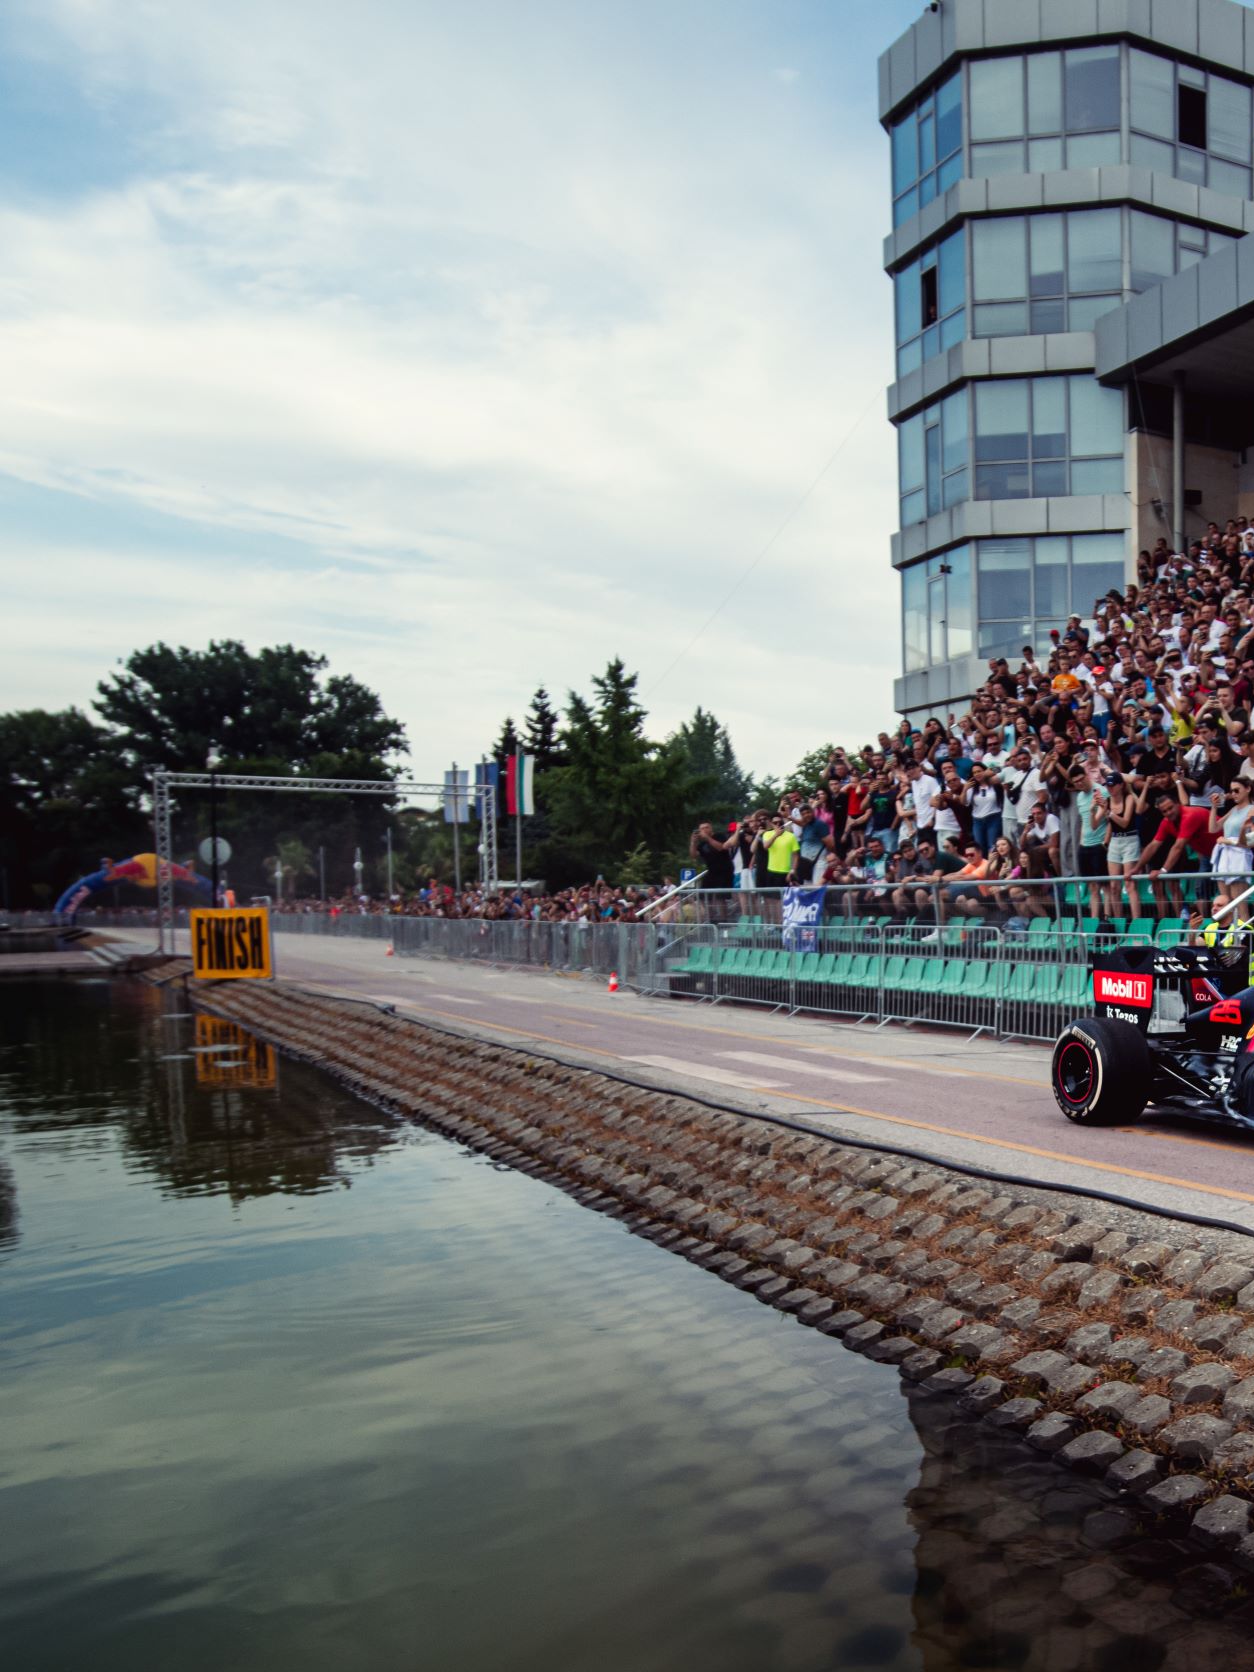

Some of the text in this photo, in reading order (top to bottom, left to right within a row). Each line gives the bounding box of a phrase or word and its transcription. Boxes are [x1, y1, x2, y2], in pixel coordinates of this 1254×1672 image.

[196, 916, 264, 970] FINISH
[1101, 977, 1133, 999] Mobil
[1195, 993, 1212, 1001] COLA
[1114, 1008, 1139, 1025] Tezos
